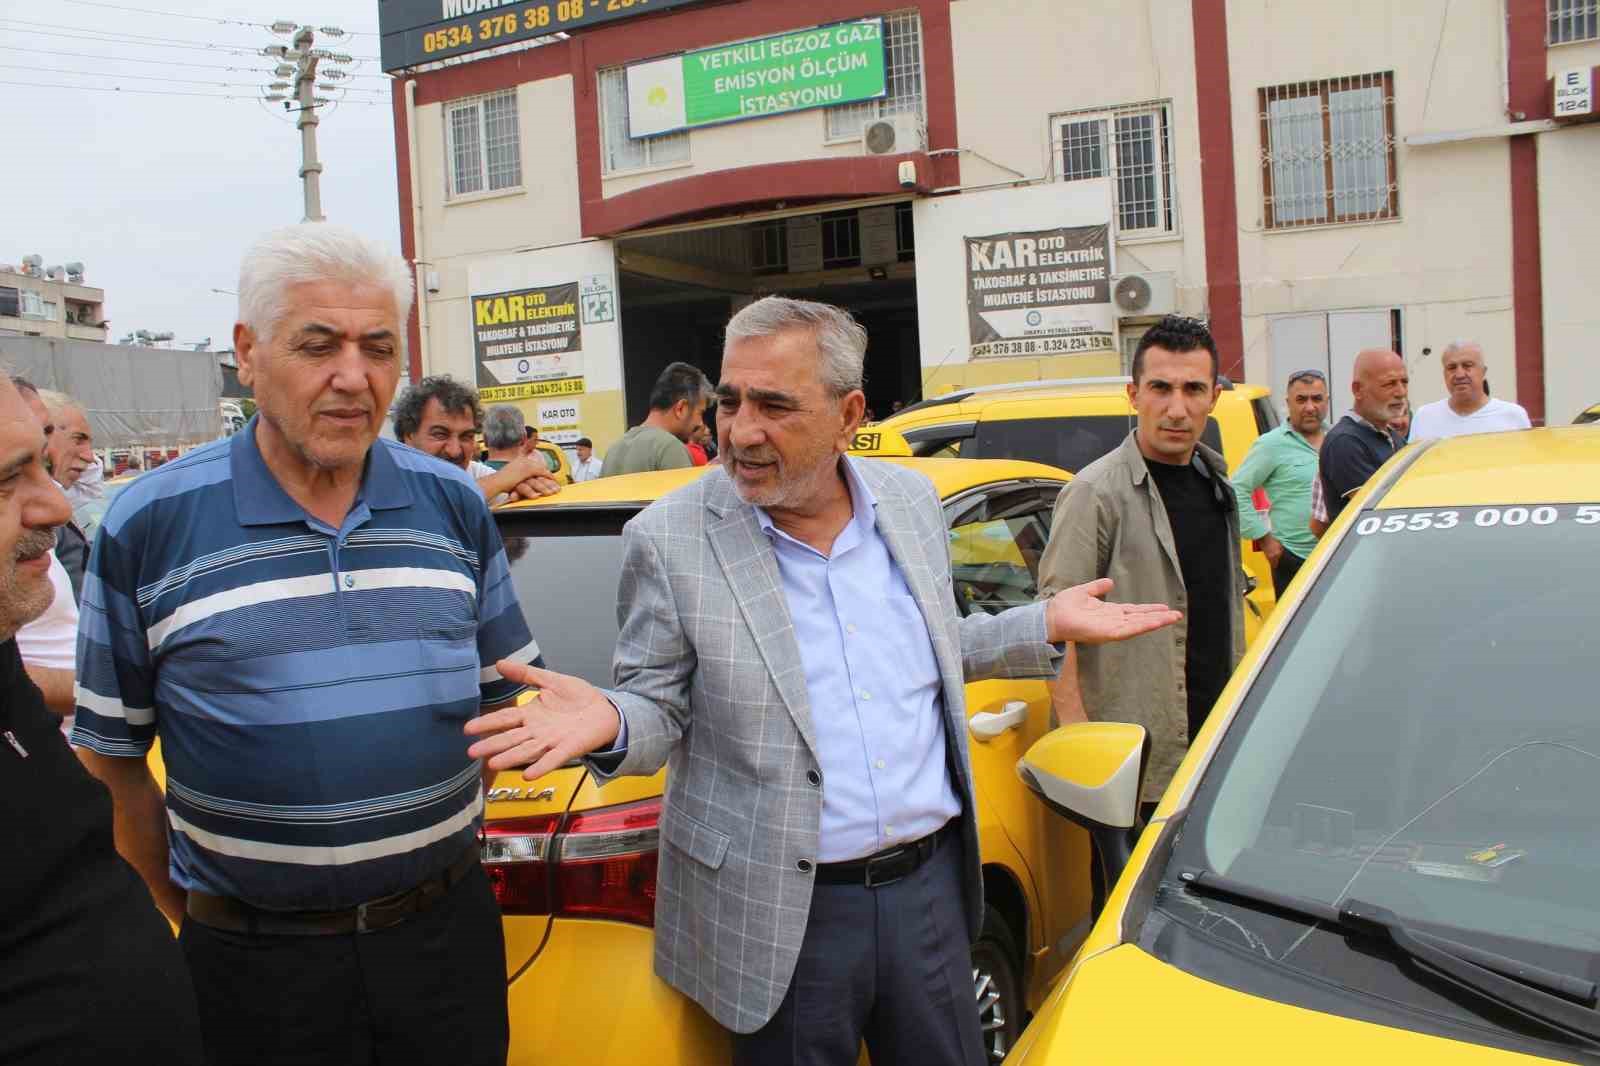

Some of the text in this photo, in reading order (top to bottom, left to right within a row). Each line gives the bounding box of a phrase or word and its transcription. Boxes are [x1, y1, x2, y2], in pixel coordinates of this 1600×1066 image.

[424, 25, 473, 53] 0534
[479, 14, 518, 40] 376
[524, 6, 550, 29] 38
[557, 0, 584, 22] 08
[699, 43, 766, 71] YETKİLİ
[770, 32, 831, 58] EGZOZ
[714, 52, 869, 94] EMİSYON ÖLÇÜM
[1567, 72, 1578, 85] E
[740, 83, 843, 114] İSTASYONU
[1557, 100, 1588, 112] 124
[971, 236, 1065, 271] KAR OTO
[1039, 246, 1105, 266] ELEKTRİK
[973, 267, 1105, 290] TAKOGRAF & TAKSİMETRE
[983, 285, 1096, 307] MUAYENE İSTASYONU
[475, 293, 546, 326] KAR OTO
[527, 302, 576, 320] ELEKTRİK
[583, 293, 612, 323] 123
[478, 320, 576, 342] TAKOGRAF & TAKSİMETRE
[525, 337, 569, 353] İSTASYONU
[1024, 341, 1036, 353] 08
[1043, 339, 1068, 351] 0.324
[1070, 338, 1087, 350] 234
[542, 408, 576, 419] KAR OTO
[1356, 511, 1459, 535] 0553
[1474, 507, 1558, 527] 000
